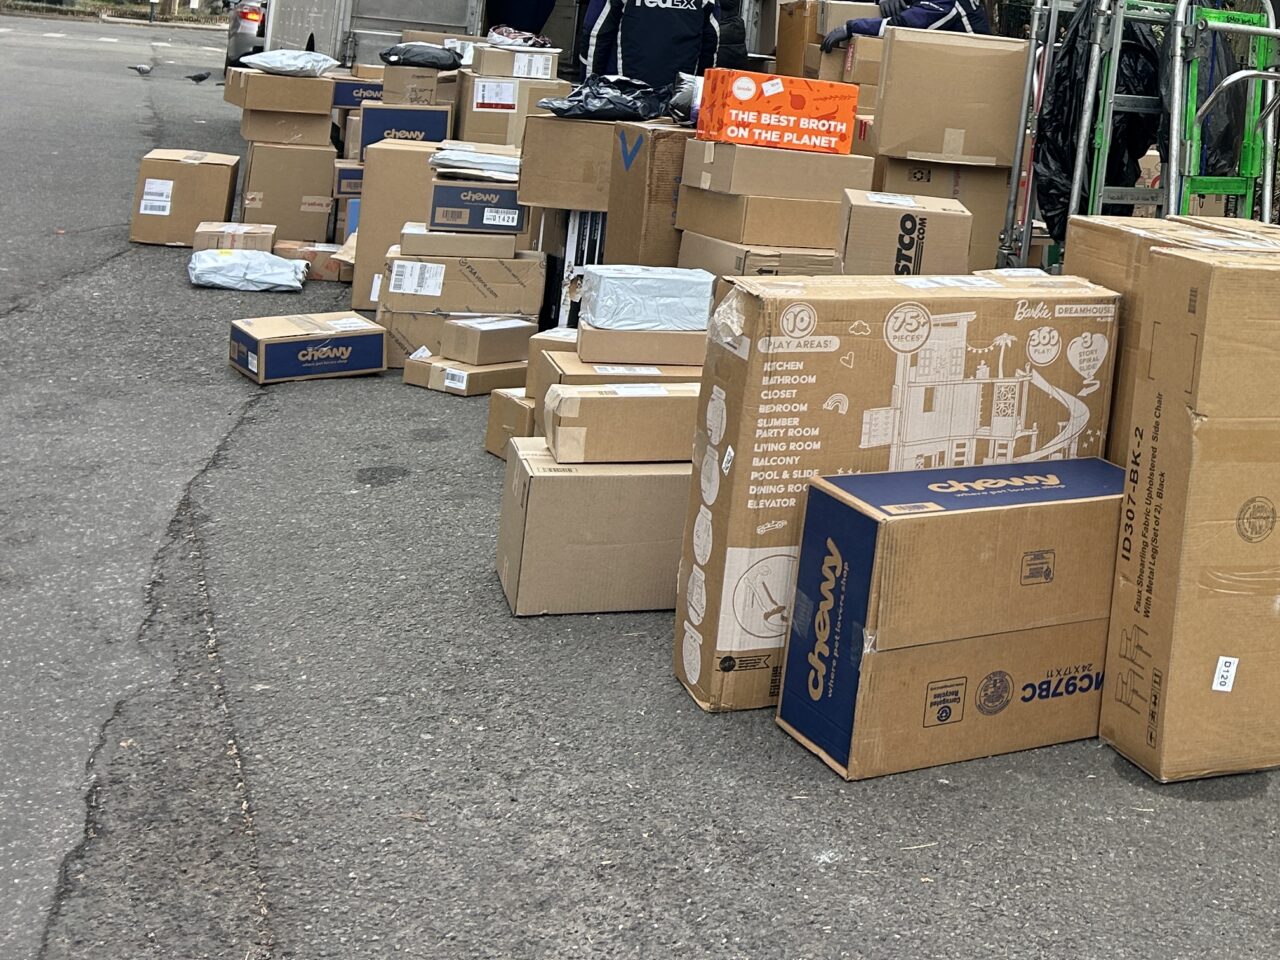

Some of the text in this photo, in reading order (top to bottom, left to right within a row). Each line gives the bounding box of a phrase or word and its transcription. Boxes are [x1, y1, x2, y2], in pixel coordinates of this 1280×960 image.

[353, 88, 384, 98] chew
[730, 109, 847, 133] THE BEST BROTH
[384, 128, 425, 140] chewy
[727, 126, 839, 148] ON THE PLANET
[461, 190, 500, 204] chewy
[894, 213, 917, 275] STCO
[1014, 300, 1113, 320] Barbie DREAMHOUSE
[785, 309, 812, 333] 10
[893, 311, 928, 332] 75+
[1029, 326, 1059, 346] 360
[1081, 332, 1092, 348] 3
[765, 339, 832, 350] PLAY AREAS!
[298, 346, 352, 361] chewy
[764, 361, 804, 371] KITCHEN
[762, 375, 816, 385] BATHROOM
[761, 389, 797, 399] CLOSET
[759, 403, 808, 413] BEDROOM
[1154, 392, 1163, 419] Chair
[757, 418, 800, 427] SLUMBER
[755, 427, 819, 438] PARTY ROOM
[754, 441, 821, 452] LIVING ROOM
[752, 456, 800, 466] BALCONY
[751, 469, 819, 480] POOL & SLIDE
[1146, 447, 1158, 506] Upholstered
[749, 484, 785, 494] DINING
[928, 474, 1060, 493] chewy
[1157, 471, 1166, 500] Black
[1121, 426, 1144, 562] ID307-BK-2
[747, 498, 796, 509] ELEVATOR
[1143, 508, 1151, 543] Fabric
[1154, 519, 1161, 528] of
[1137, 545, 1149, 587] Shearling
[1146, 568, 1155, 593] Metal
[1134, 588, 1143, 614] Faux
[1143, 594, 1152, 618] With
[808, 537, 842, 701] chewy
[828, 659, 837, 698] where
[835, 594, 844, 634] lovers
[841, 561, 849, 591] shop
[1055, 669, 1062, 677] X
[1063, 667, 1072, 675] 17
[1073, 665, 1080, 673] X
[1082, 663, 1093, 672] 24
